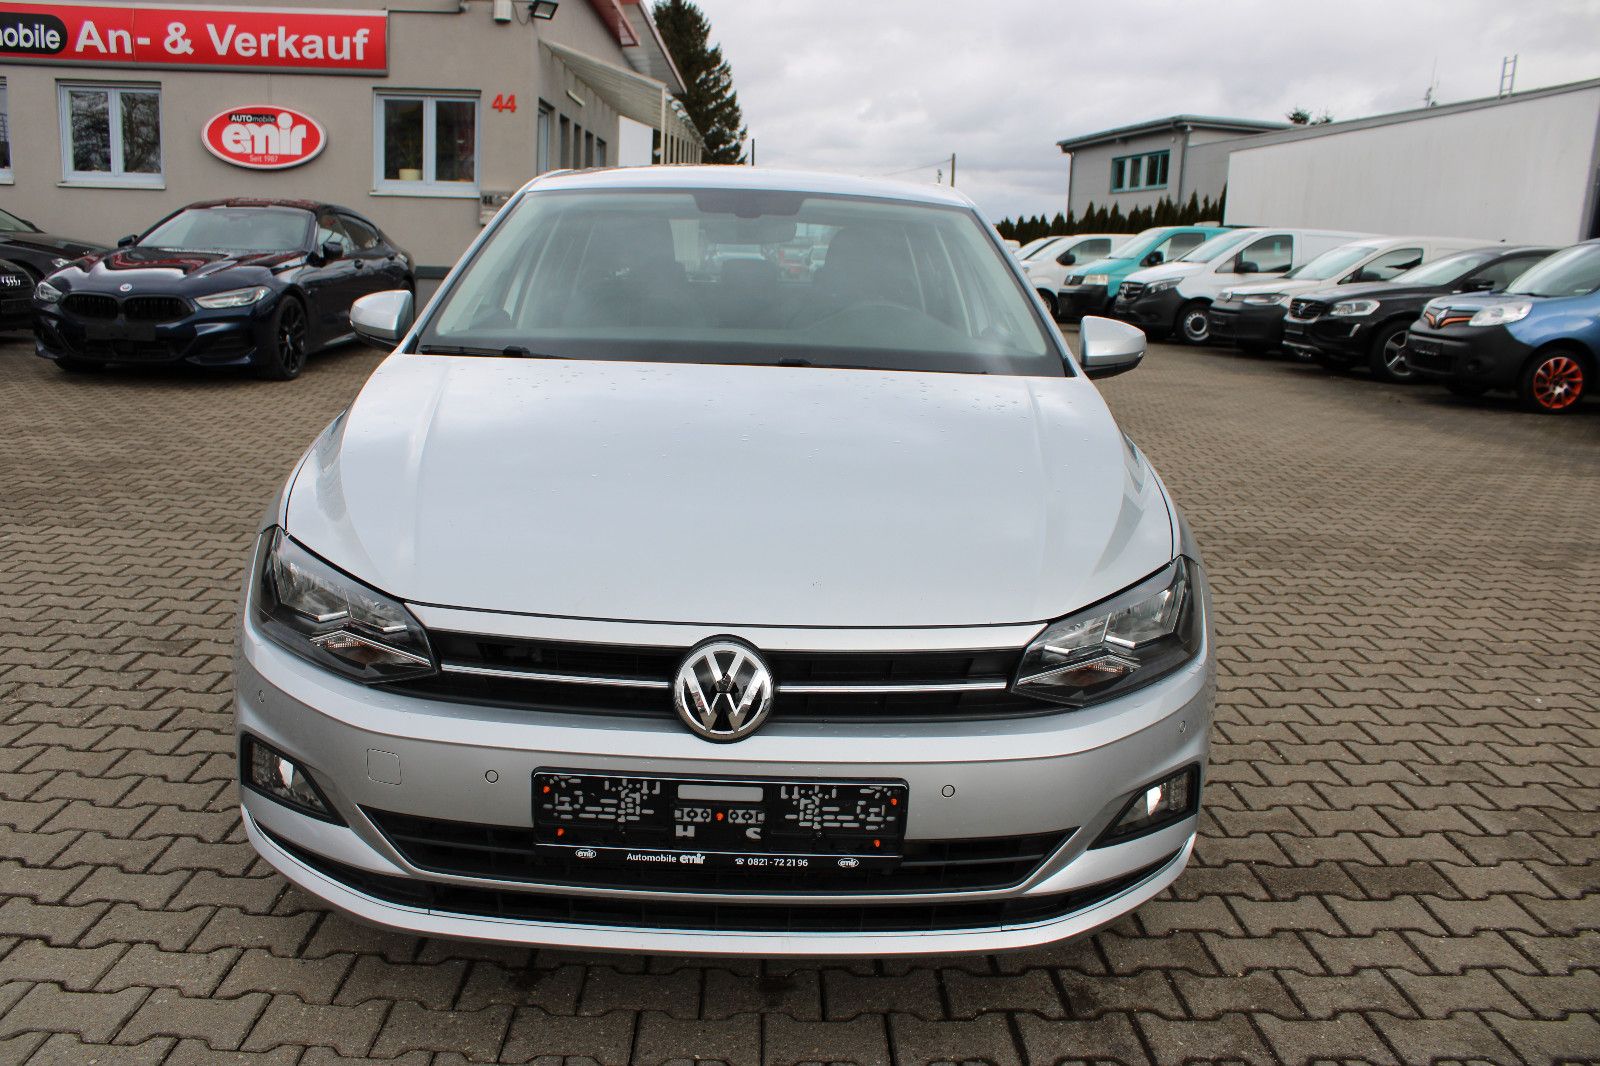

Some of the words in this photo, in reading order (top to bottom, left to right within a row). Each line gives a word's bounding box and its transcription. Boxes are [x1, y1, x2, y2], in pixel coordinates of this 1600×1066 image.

[0, 22, 61, 50] obile
[75, 20, 151, 54] An-
[163, 22, 195, 56] &
[206, 23, 370, 61] Verkauf
[492, 94, 516, 113] 44
[231, 114, 276, 123] AUTOmobile
[221, 112, 307, 156] emir
[626, 853, 677, 863] Automobile
[679, 852, 706, 864] emir
